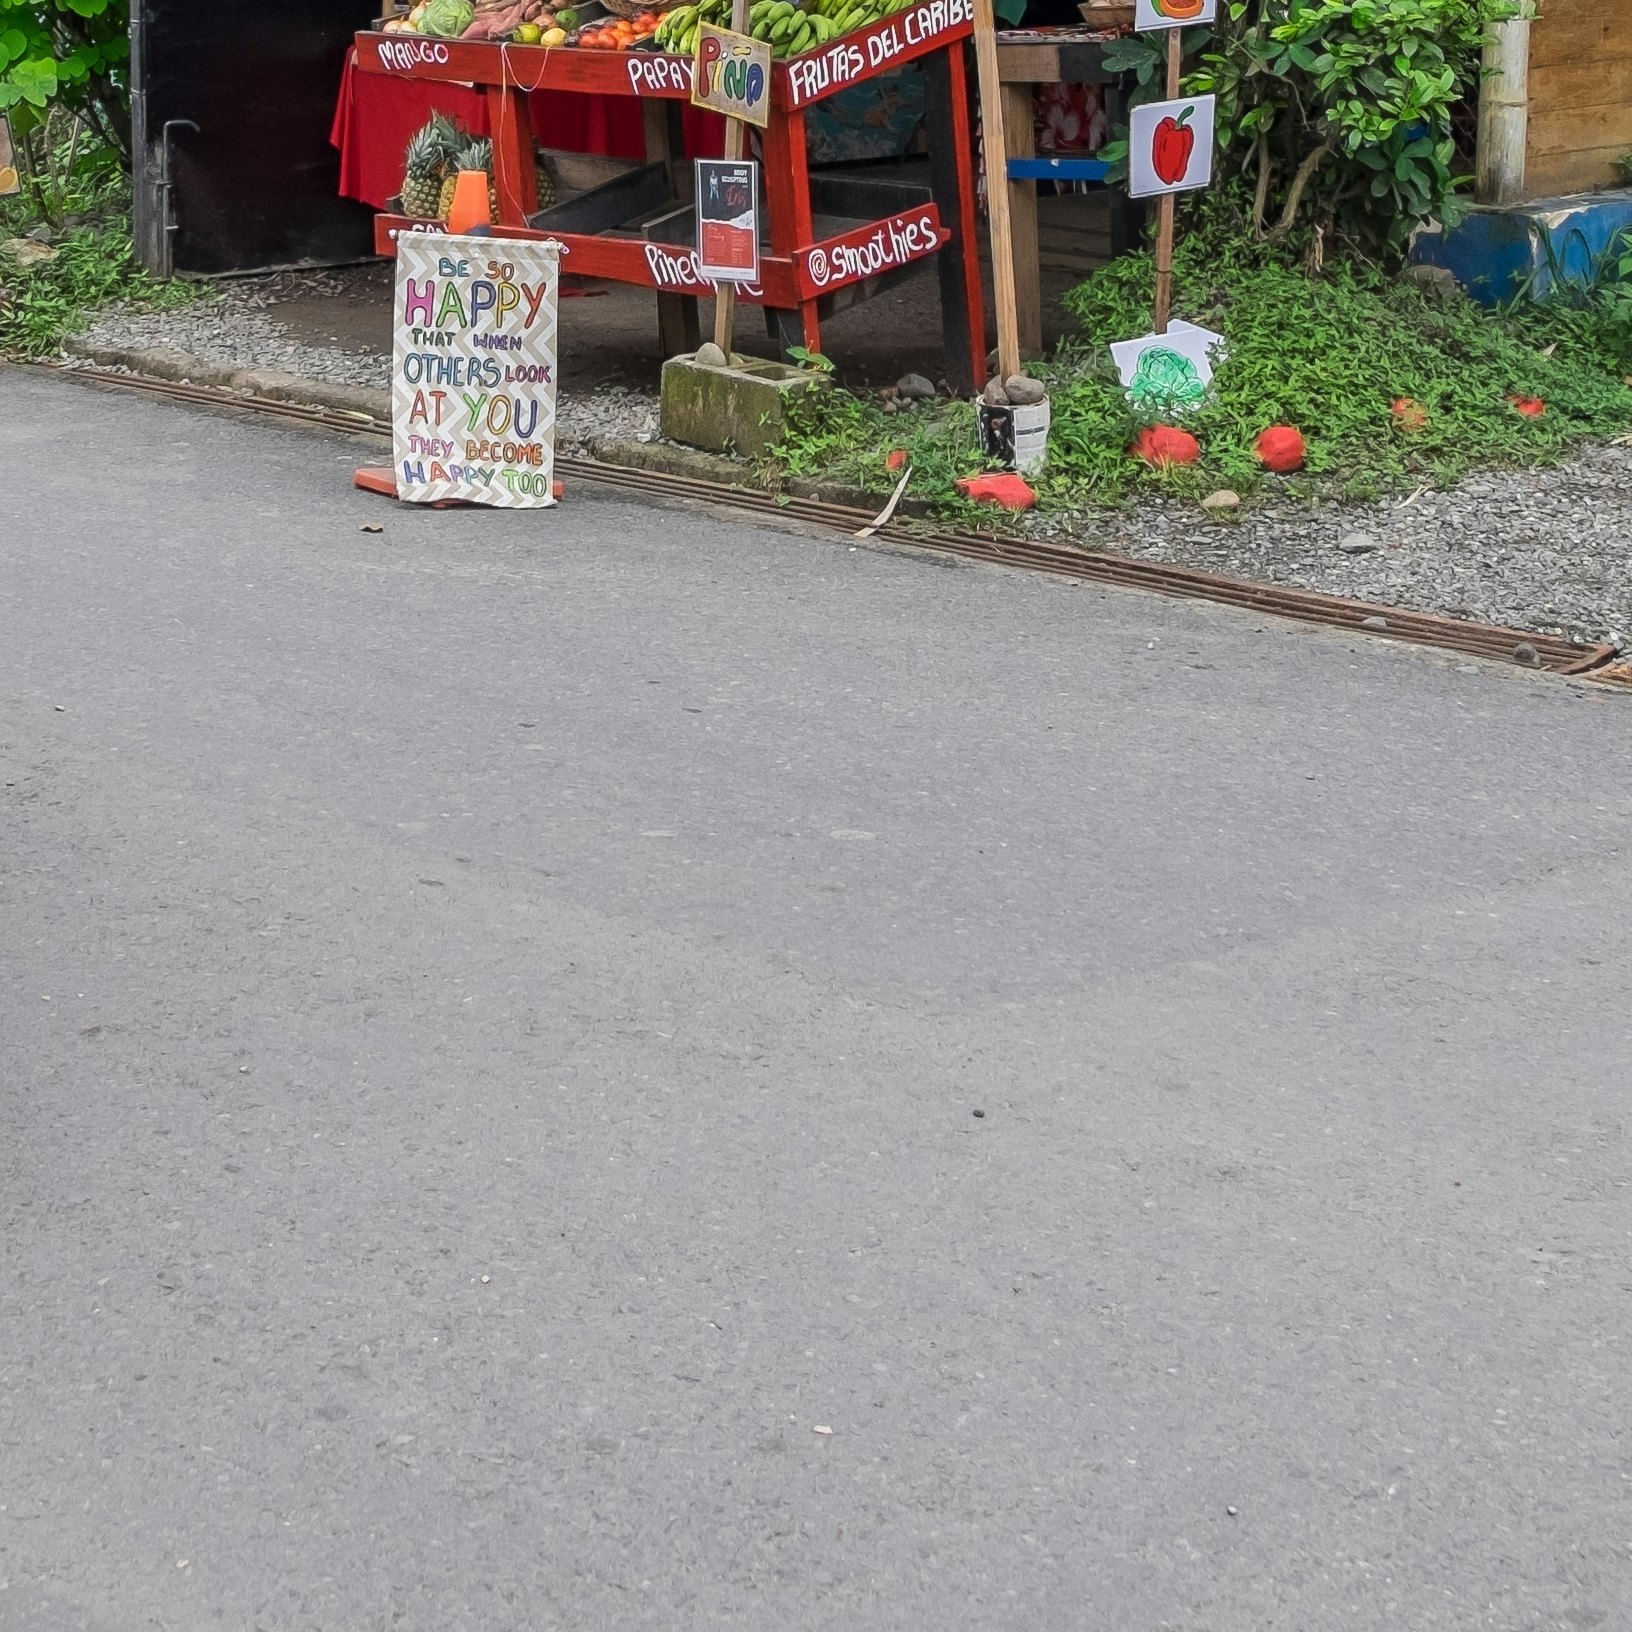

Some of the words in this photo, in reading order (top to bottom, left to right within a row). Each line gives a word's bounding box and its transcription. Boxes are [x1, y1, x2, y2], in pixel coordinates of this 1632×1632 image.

[378, 41, 450, 72] MANGO
[788, 44, 864, 106] FRUTAS
[867, 24, 905, 68] DEL
[627, 56, 696, 96] PAPAY
[438, 257, 470, 278] BE
[484, 260, 515, 282] SO
[404, 277, 547, 330] HAPPY
[411, 327, 456, 347] THAT
[473, 332, 523, 351] WHEN
[403, 352, 502, 389] OTHERS
[504, 364, 552, 384] LOOK
[408, 388, 448, 426] AT
[462, 392, 539, 439] YOU
[407, 434, 455, 459] THEY
[465, 439, 544, 466] BECOME
[403, 459, 496, 488] HAPPY
[501, 468, 548, 498] TOO
